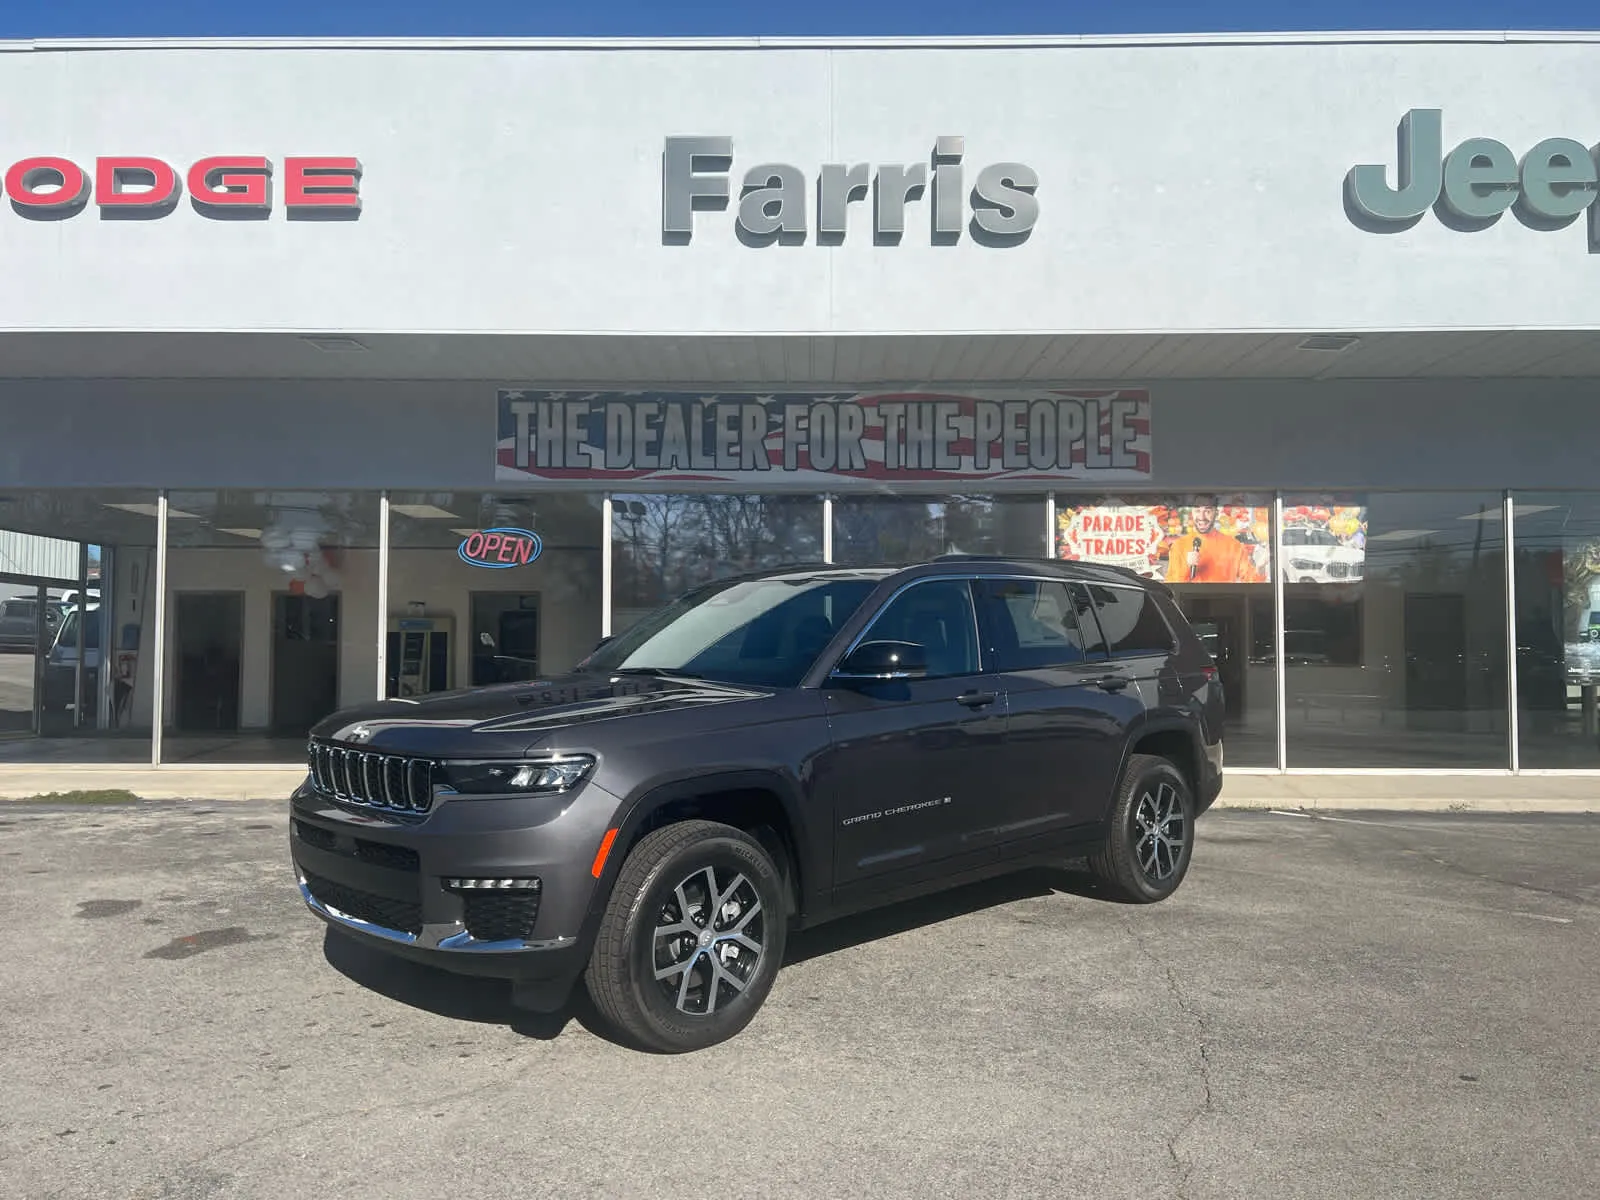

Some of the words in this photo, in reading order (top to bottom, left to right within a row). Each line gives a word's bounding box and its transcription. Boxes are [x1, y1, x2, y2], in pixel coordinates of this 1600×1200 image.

[0, 156, 362, 221] ODGE
[662, 135, 1041, 248] Farris
[1342, 108, 1600, 254] Jee
[511, 400, 593, 468] THE
[605, 400, 771, 471] DEALER
[783, 400, 867, 472] FOR
[878, 400, 961, 470] THE
[974, 399, 1138, 470] PEOPLE
[1081, 538, 1146, 555] TRADES
[1082, 515, 1145, 532] PARADE
[465, 532, 534, 565] OPEN
[842, 811, 882, 826] GRAND
[884, 799, 942, 816] CHEROKEE
